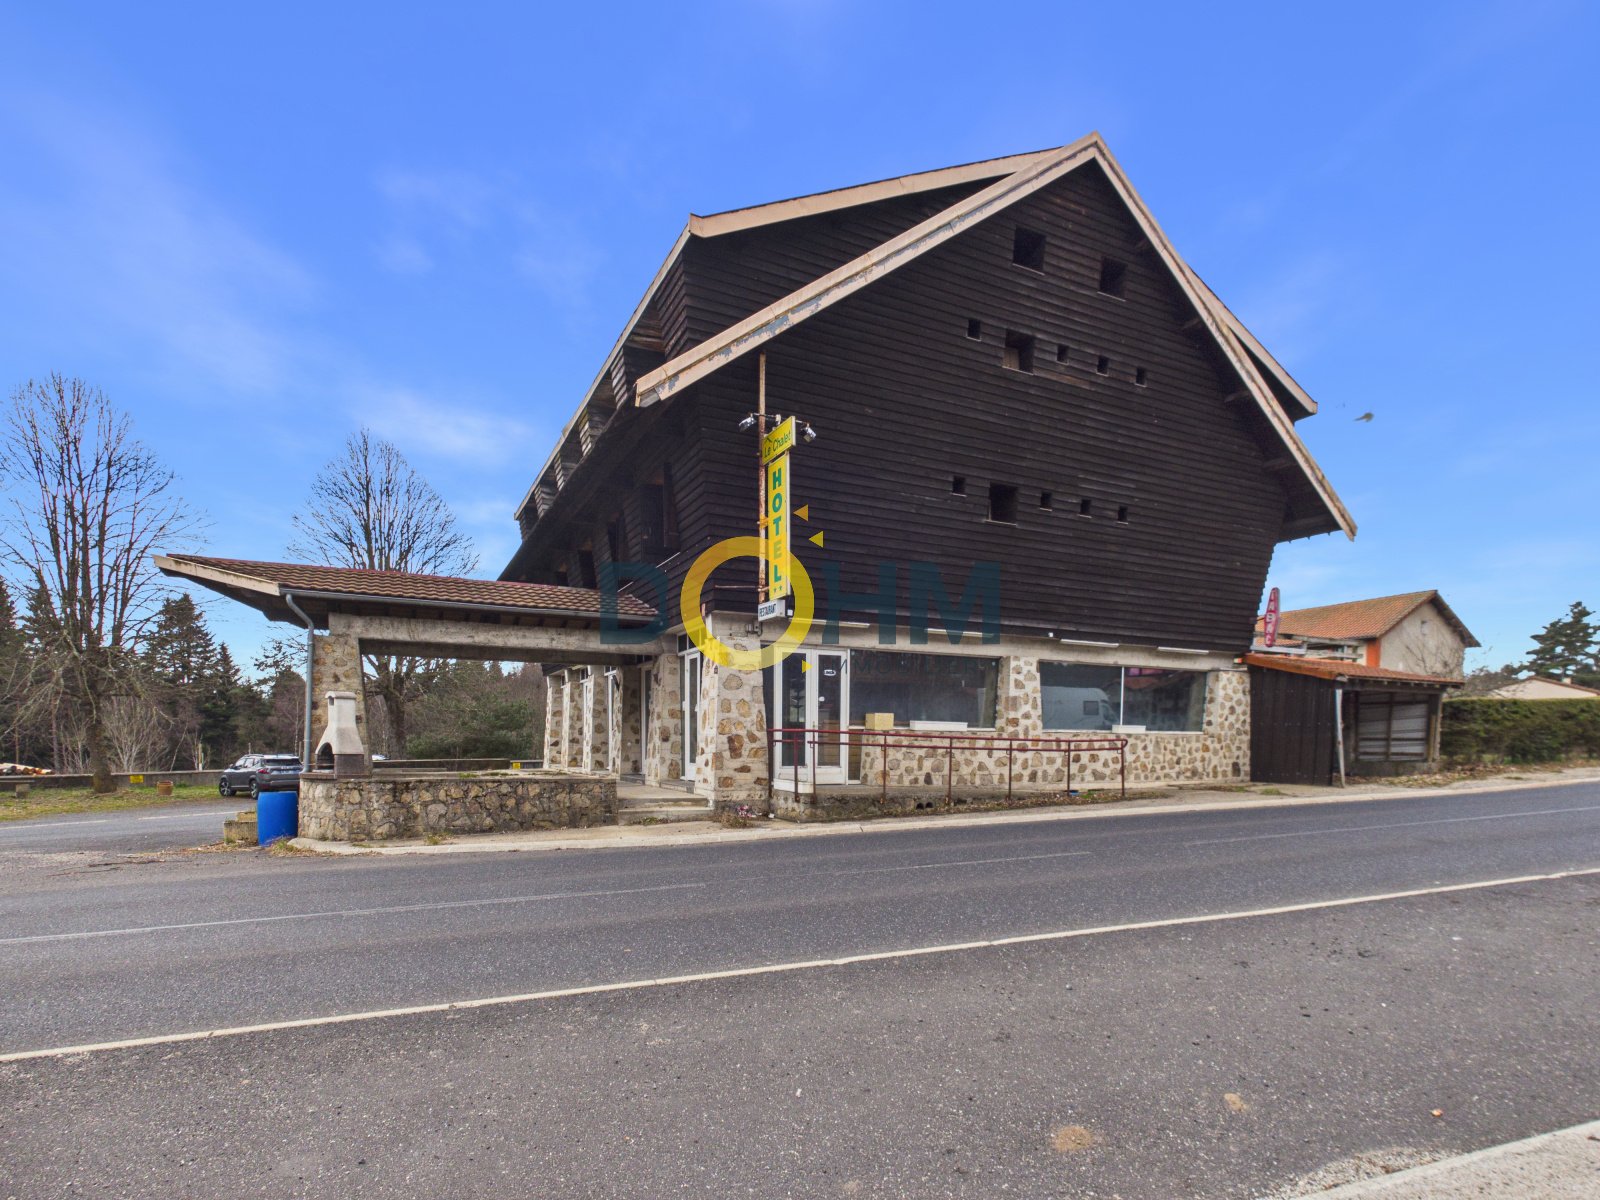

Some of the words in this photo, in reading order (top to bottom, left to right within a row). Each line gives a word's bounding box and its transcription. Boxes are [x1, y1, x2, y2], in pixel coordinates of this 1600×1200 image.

[773, 429, 791, 452] Chalet
[772, 467, 783, 583] HOTEL
[1266, 591, 1276, 645] TABAC
